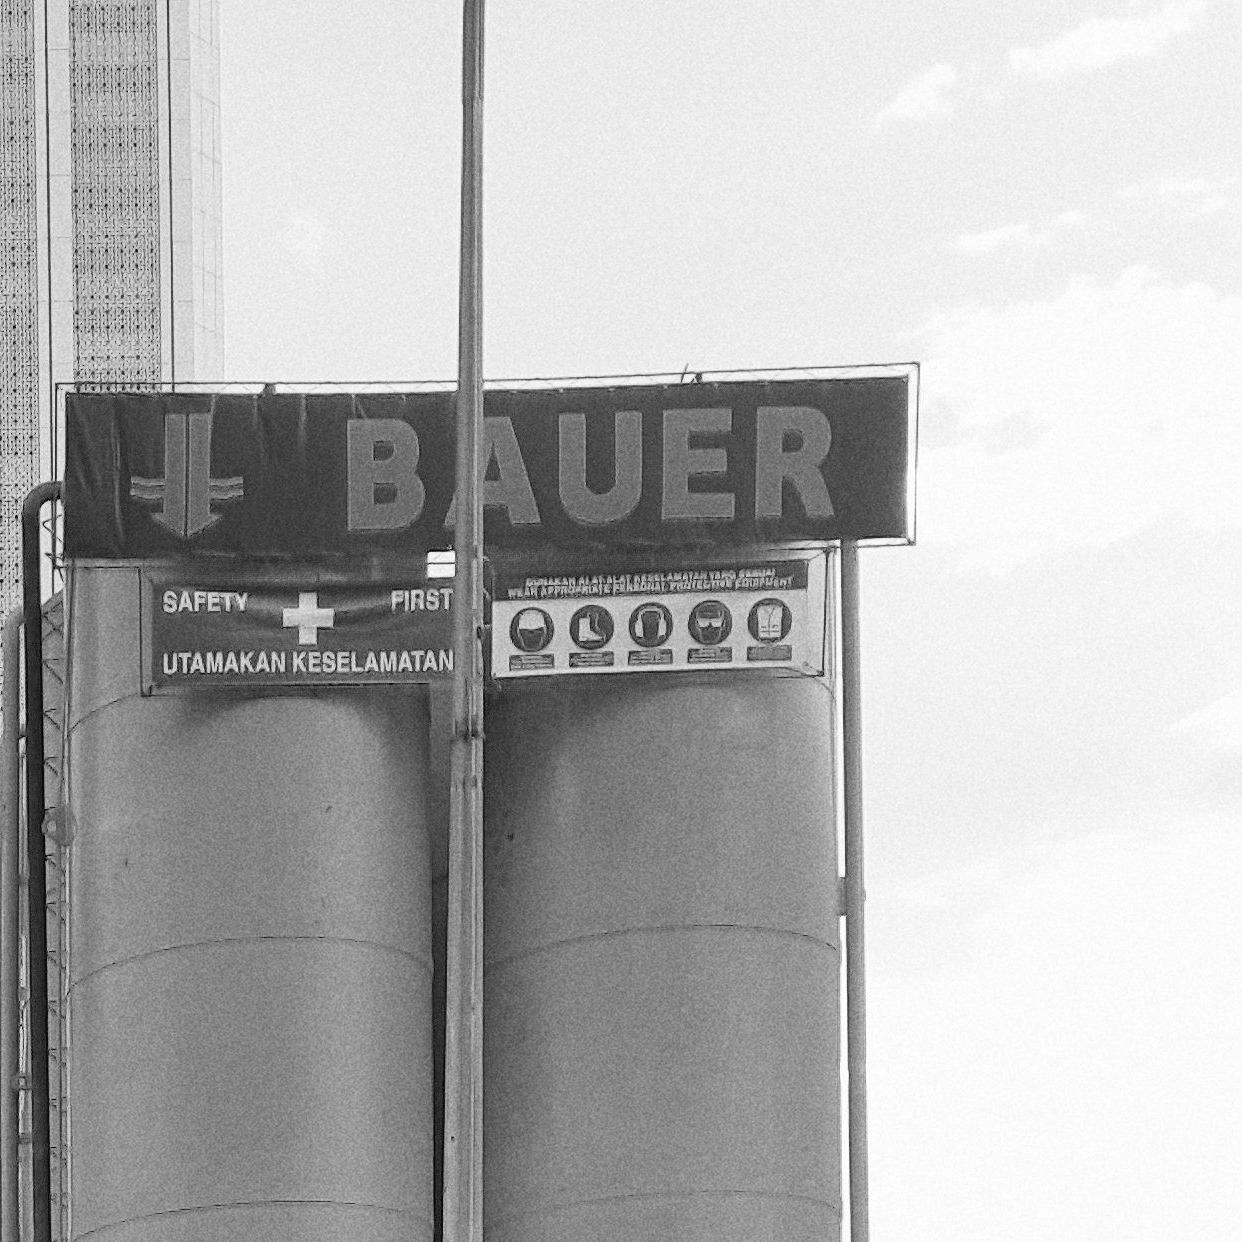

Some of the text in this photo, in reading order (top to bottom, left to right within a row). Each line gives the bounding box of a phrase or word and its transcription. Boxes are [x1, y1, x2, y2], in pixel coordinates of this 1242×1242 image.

[346, 406, 835, 531] BAUER
[162, 587, 454, 613] SAFETY FIRST
[162, 650, 454, 675] UTAMAKAN KESELAMATAN
